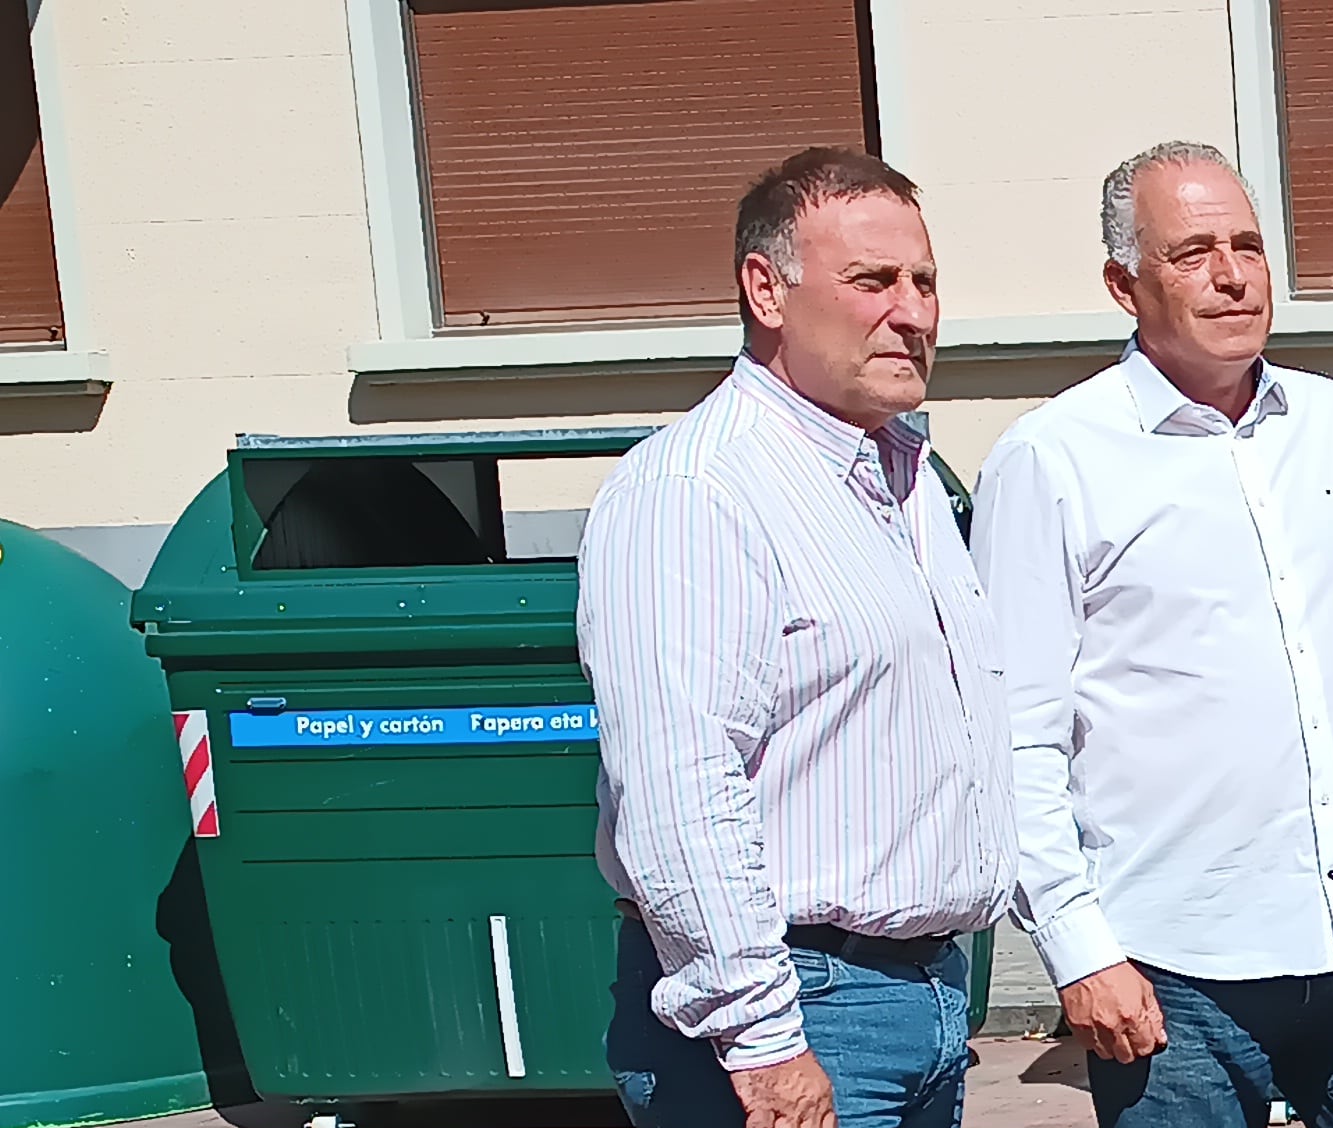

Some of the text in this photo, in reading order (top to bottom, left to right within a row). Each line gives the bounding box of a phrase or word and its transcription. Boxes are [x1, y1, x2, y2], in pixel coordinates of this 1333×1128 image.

[296, 714, 354, 739] Papel
[360, 719, 374, 739] y
[379, 715, 444, 733] cartón
[549, 712, 583, 729] eta
